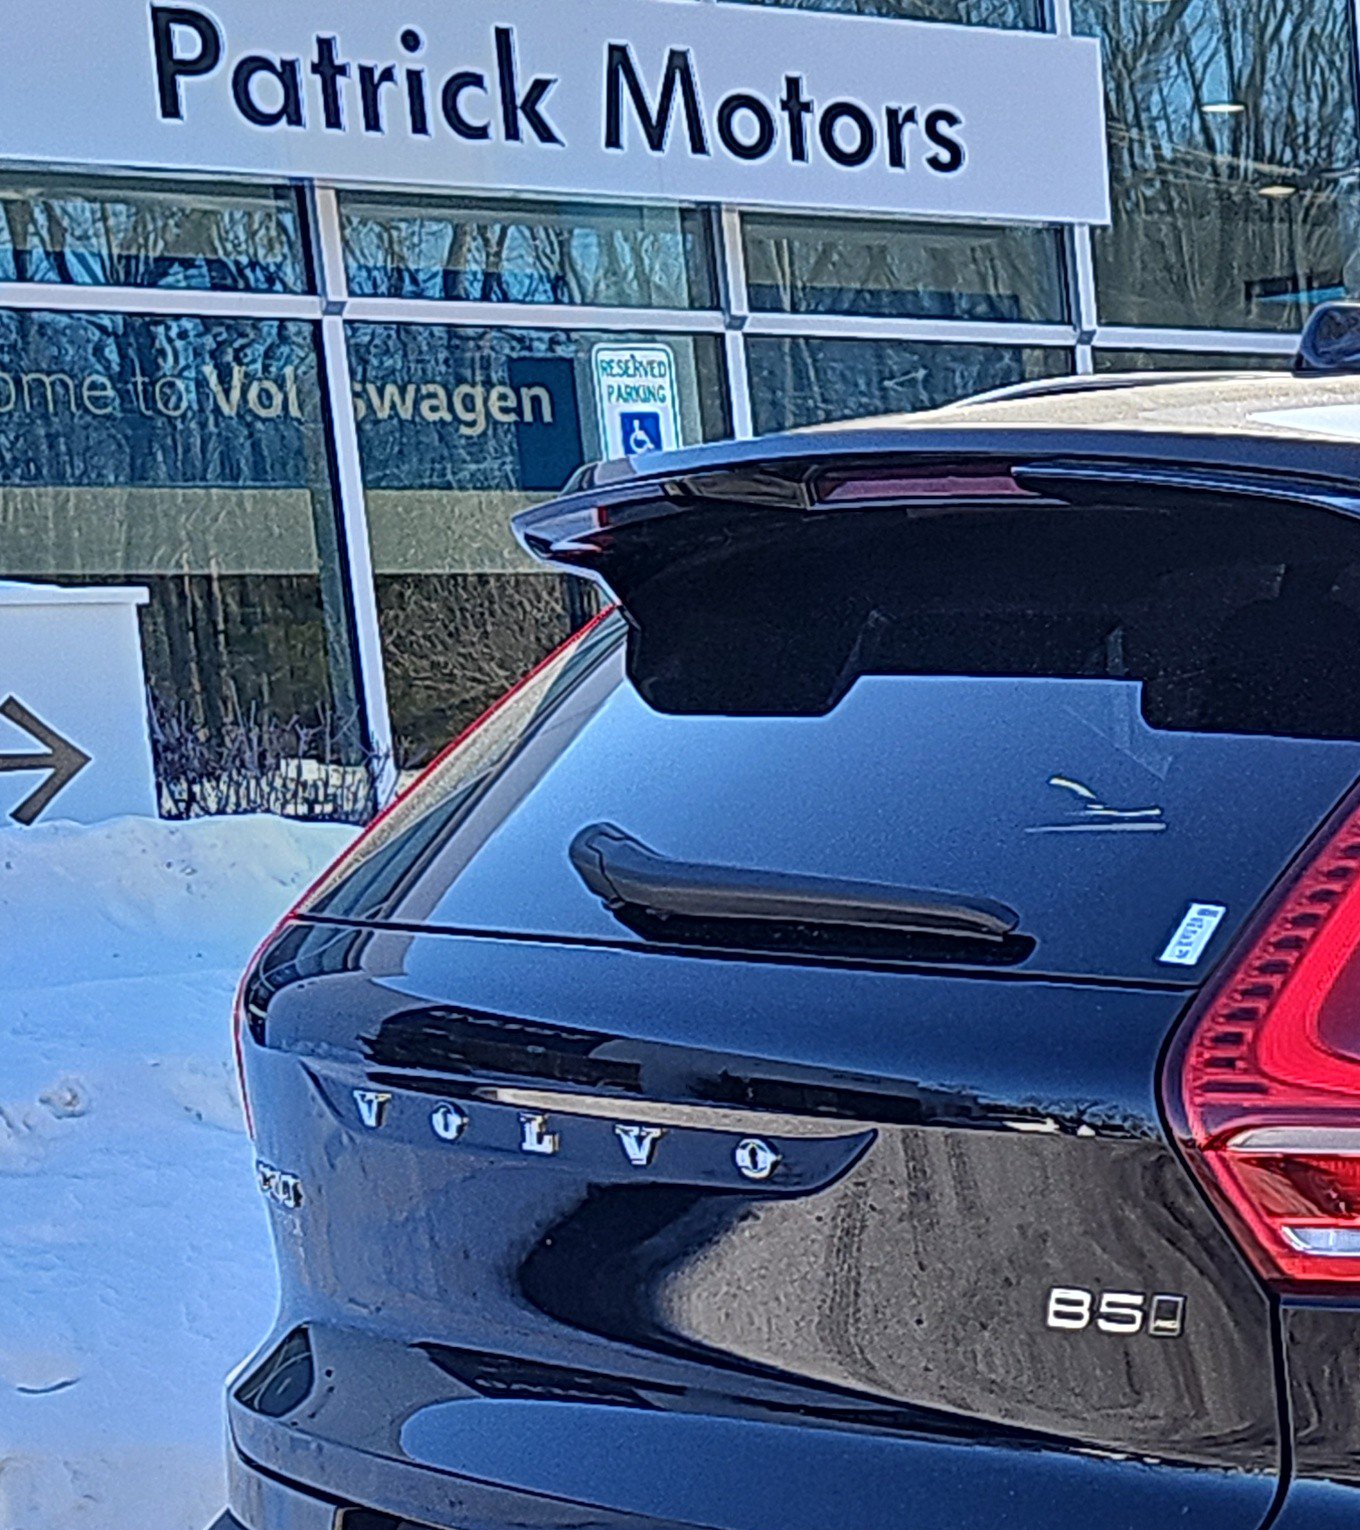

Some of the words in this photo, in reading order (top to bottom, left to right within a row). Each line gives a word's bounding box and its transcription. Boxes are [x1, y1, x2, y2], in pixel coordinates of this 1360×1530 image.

[150, 4, 566, 147] Patrick
[604, 42, 967, 174] Motors
[600, 358, 667, 379] RESERVED
[606, 383, 667, 404] PARKING
[131, 373, 191, 418] to
[203, 364, 555, 435] Volswagen
[352, 1088, 783, 1181] VOLVO
[1047, 1287, 1146, 1334] B5
